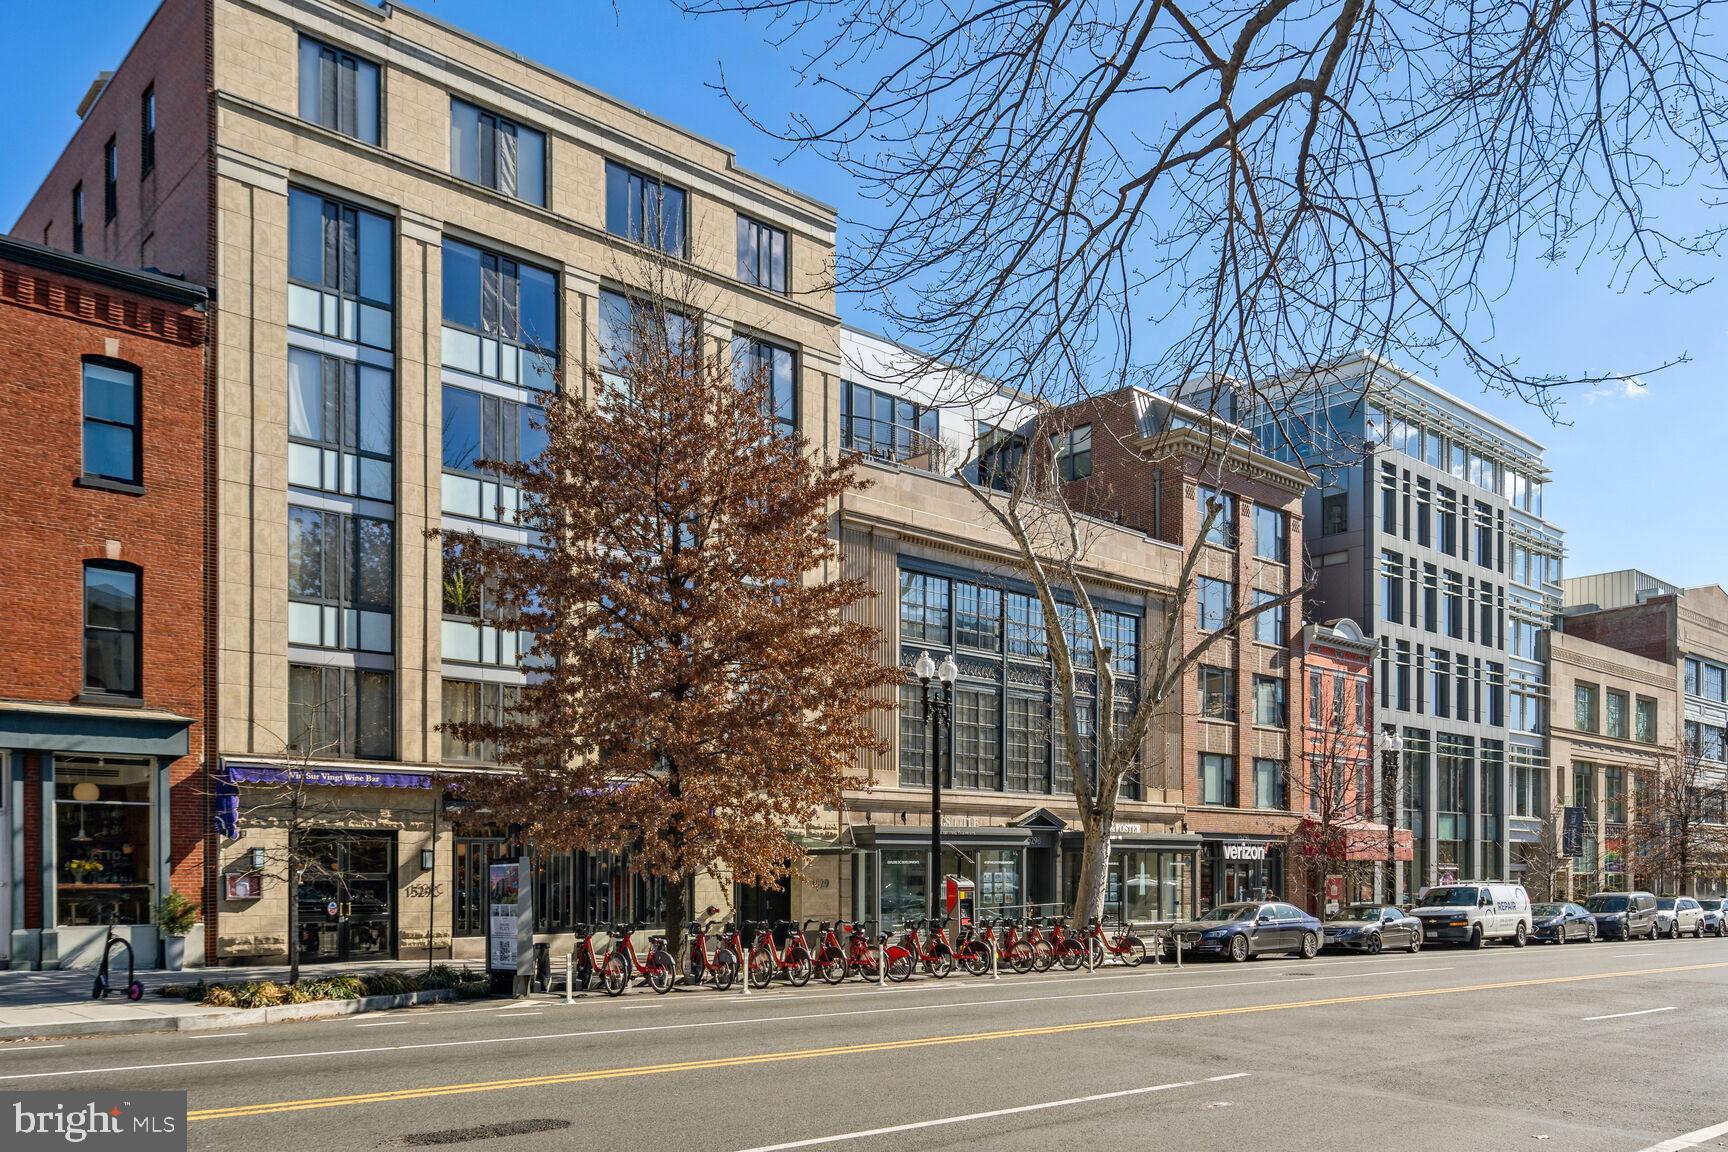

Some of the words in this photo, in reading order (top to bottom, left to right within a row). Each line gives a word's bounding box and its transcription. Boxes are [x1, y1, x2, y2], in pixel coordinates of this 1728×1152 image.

[305, 772, 320, 780] Sur
[321, 773, 343, 782] Vingt
[344, 773, 364, 782] Wine
[366, 774, 380, 782] Bar
[1116, 823, 1141, 834] FOSTER
[1223, 842, 1265, 860] verizon
[1497, 901, 1518, 911] REPAIR
